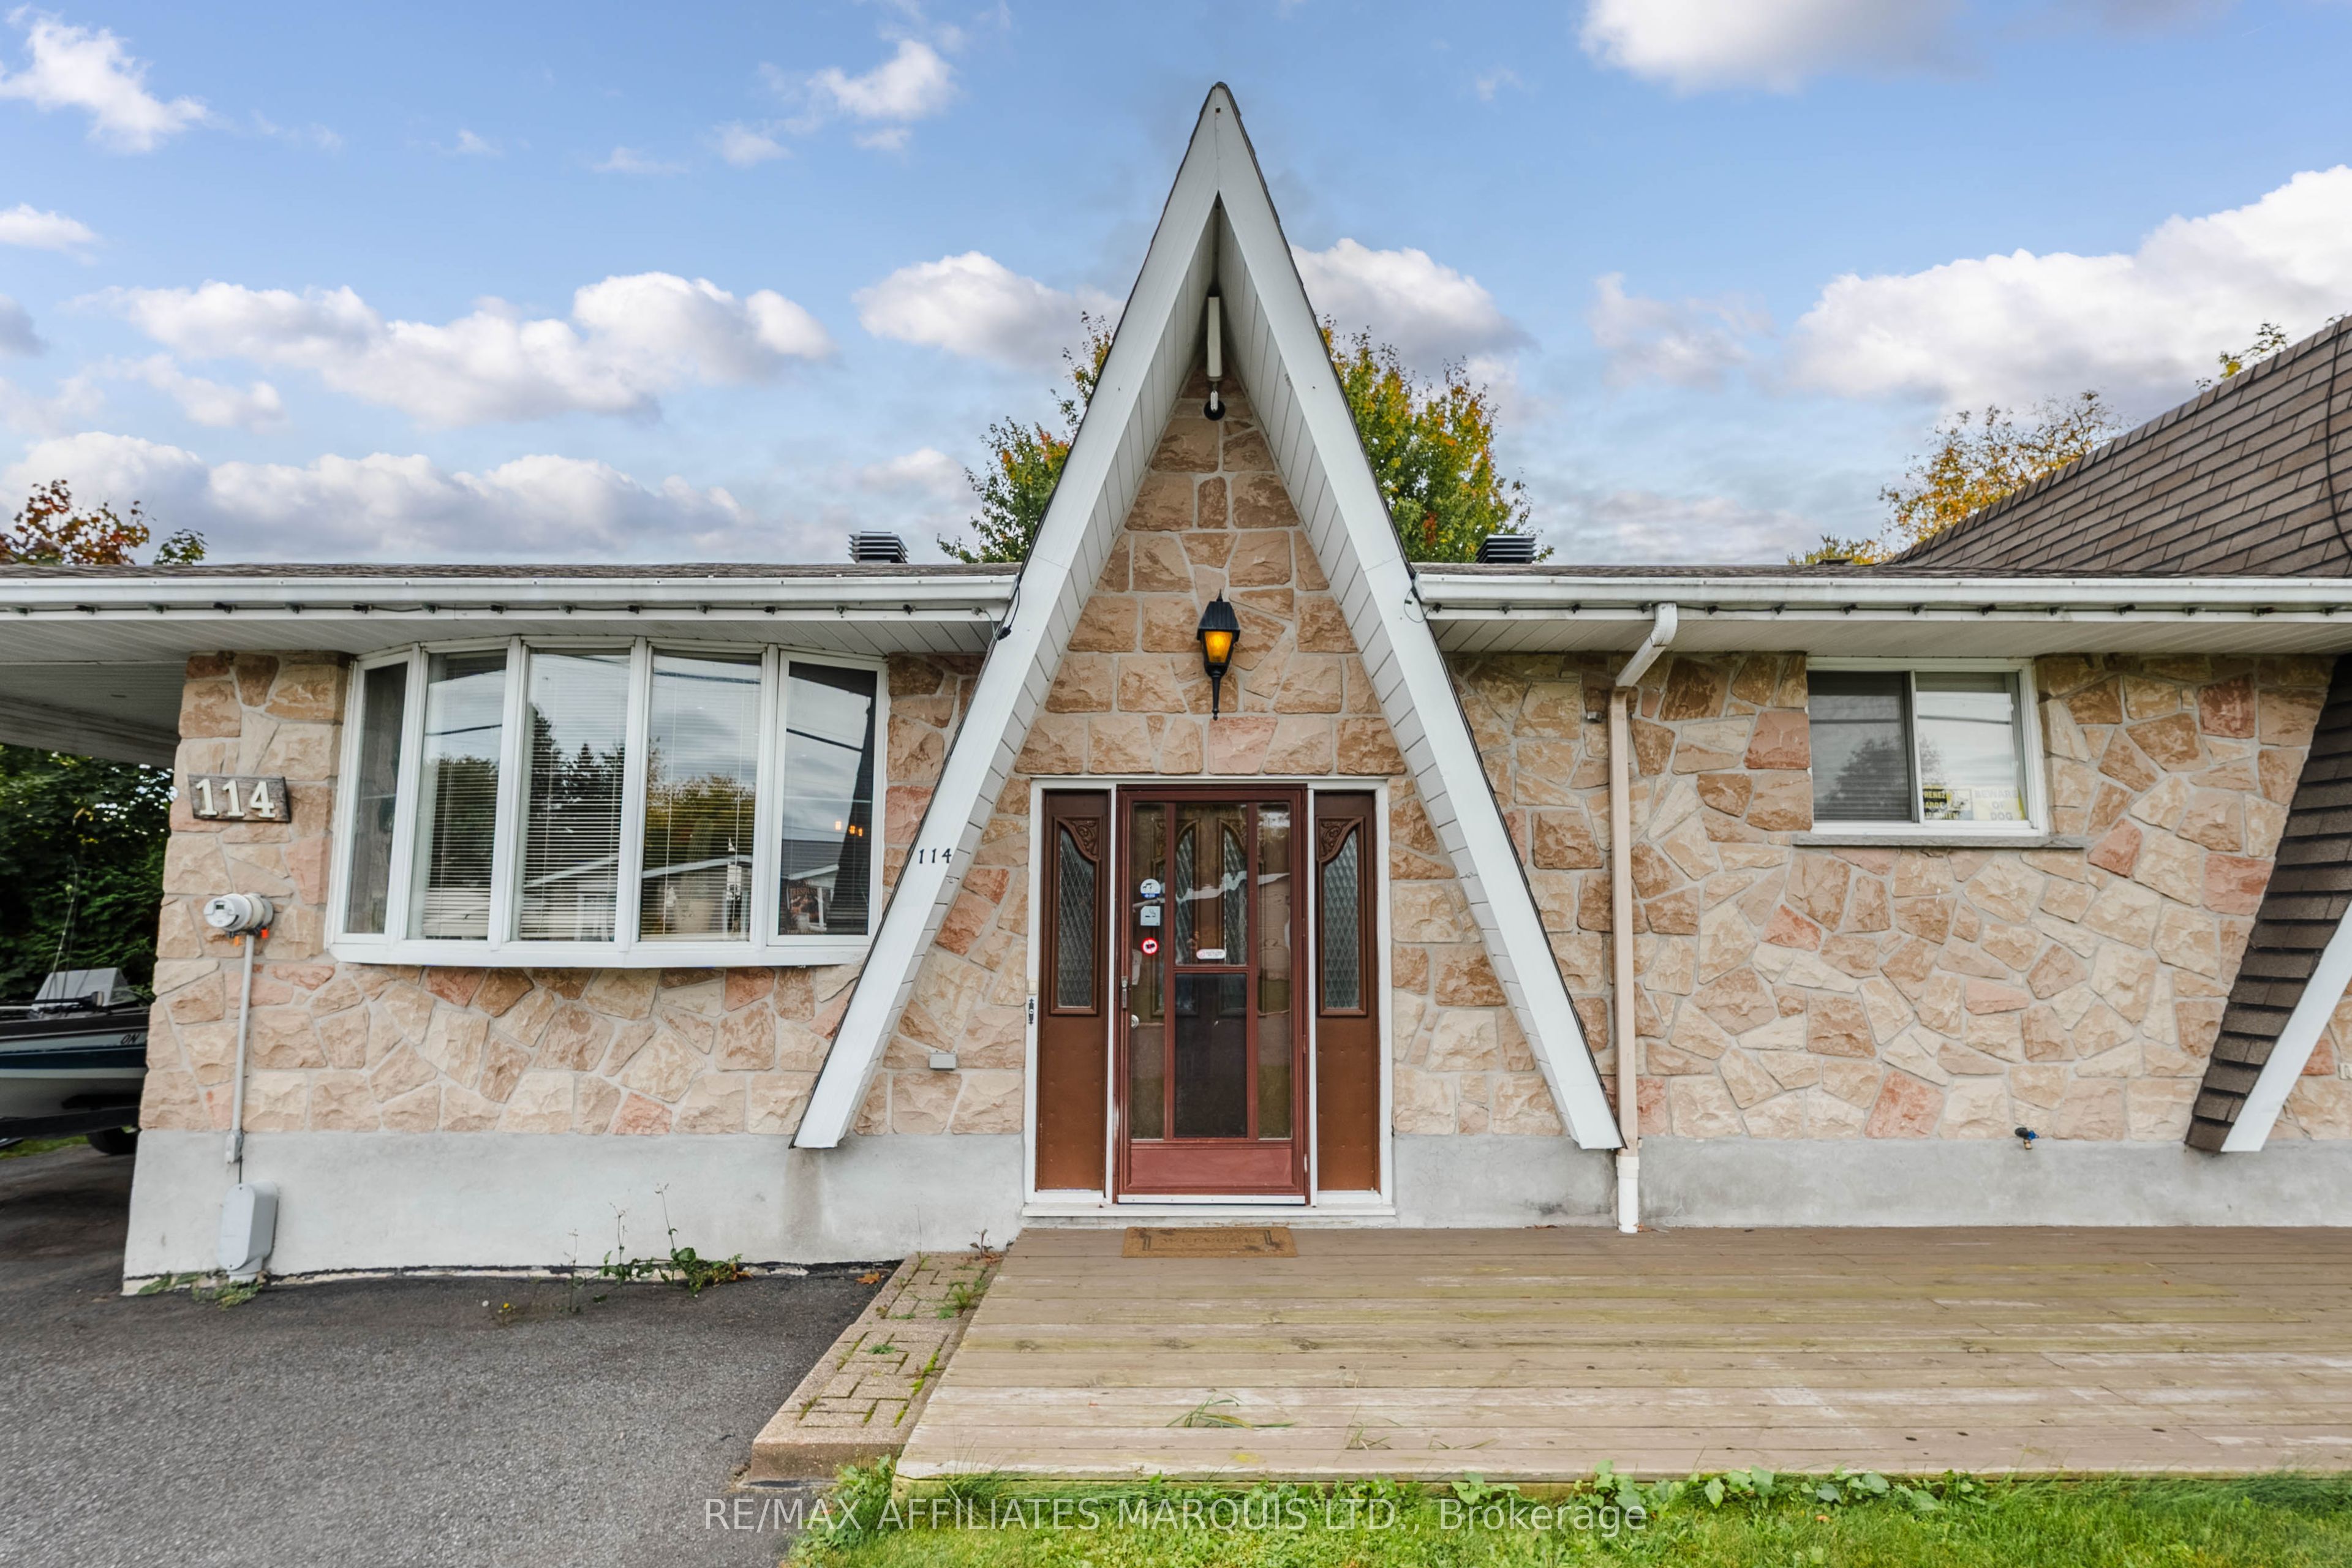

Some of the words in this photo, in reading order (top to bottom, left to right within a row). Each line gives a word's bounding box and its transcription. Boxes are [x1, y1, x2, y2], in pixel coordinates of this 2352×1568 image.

[196, 778, 276, 818] 114
[1990, 812, 2013, 821] DOG
[919, 848, 952, 864] 114
[121, 1033, 140, 1044] ON
